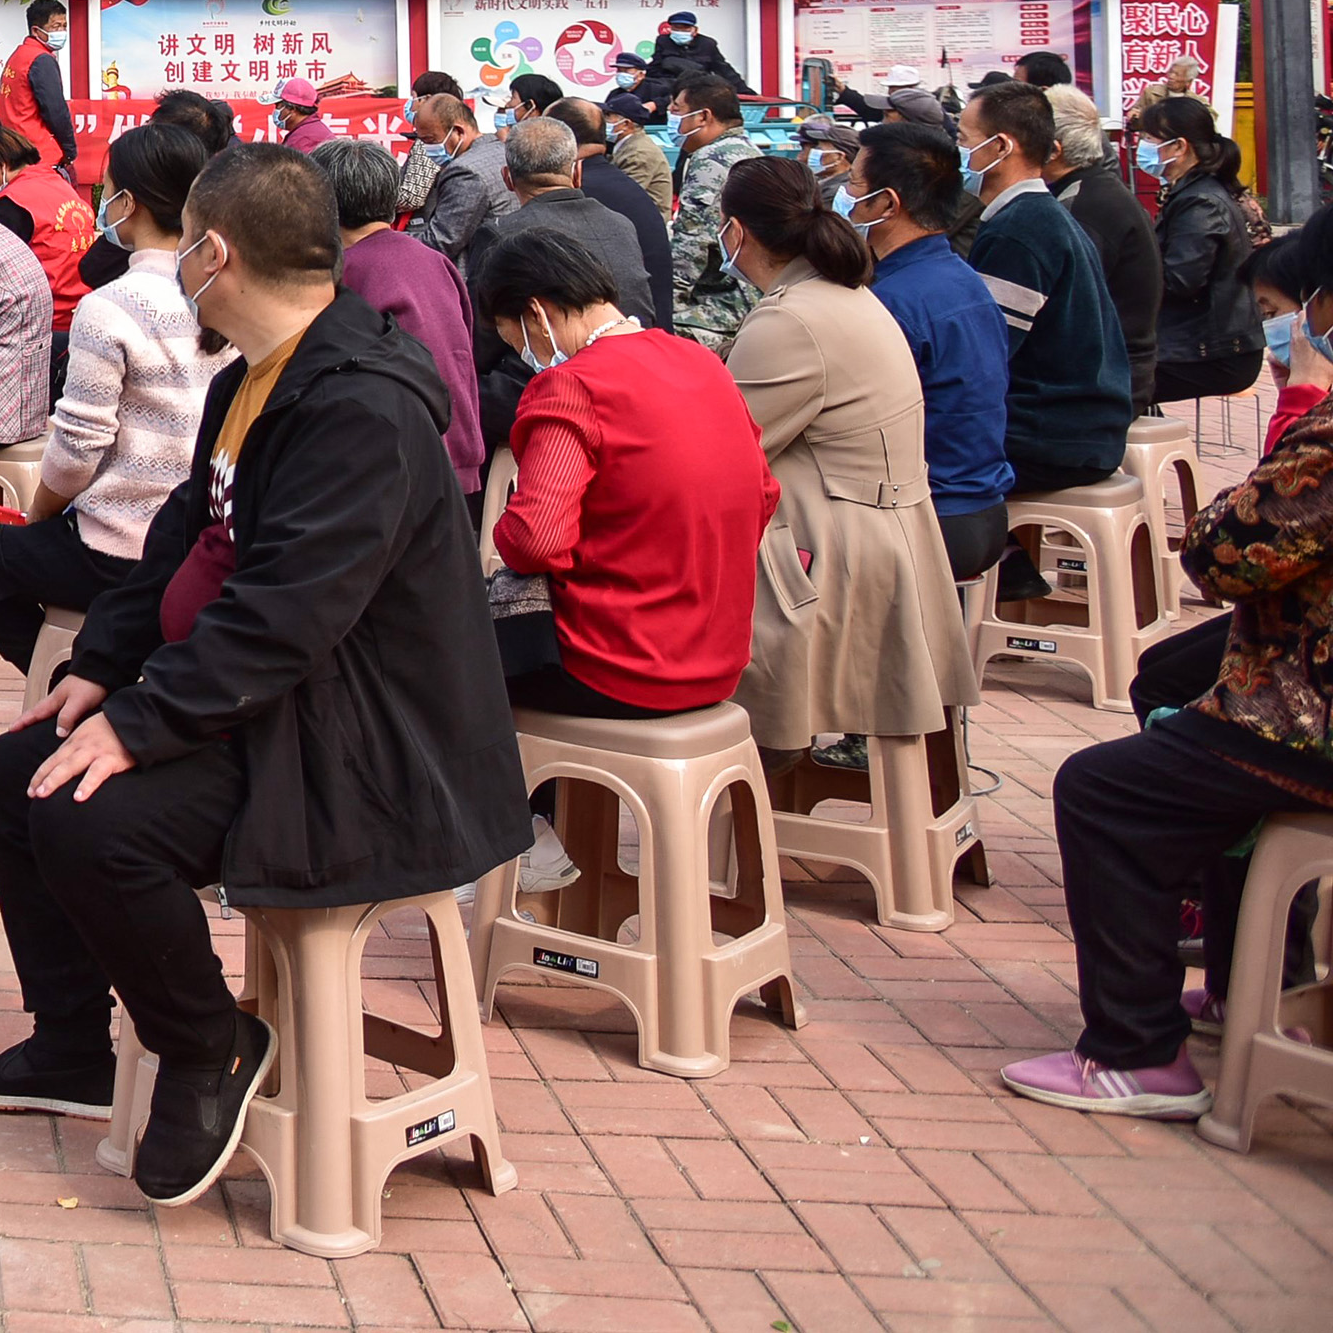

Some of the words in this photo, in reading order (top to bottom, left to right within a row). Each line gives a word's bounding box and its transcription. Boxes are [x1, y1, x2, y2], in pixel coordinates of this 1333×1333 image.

[1122, 2, 1210, 37] 聚民心
[158, 34, 236, 57] 讲文明
[253, 32, 333, 56] 树新风
[1122, 40, 1209, 74] 育新人
[164, 60, 328, 83] 创建文明城市
